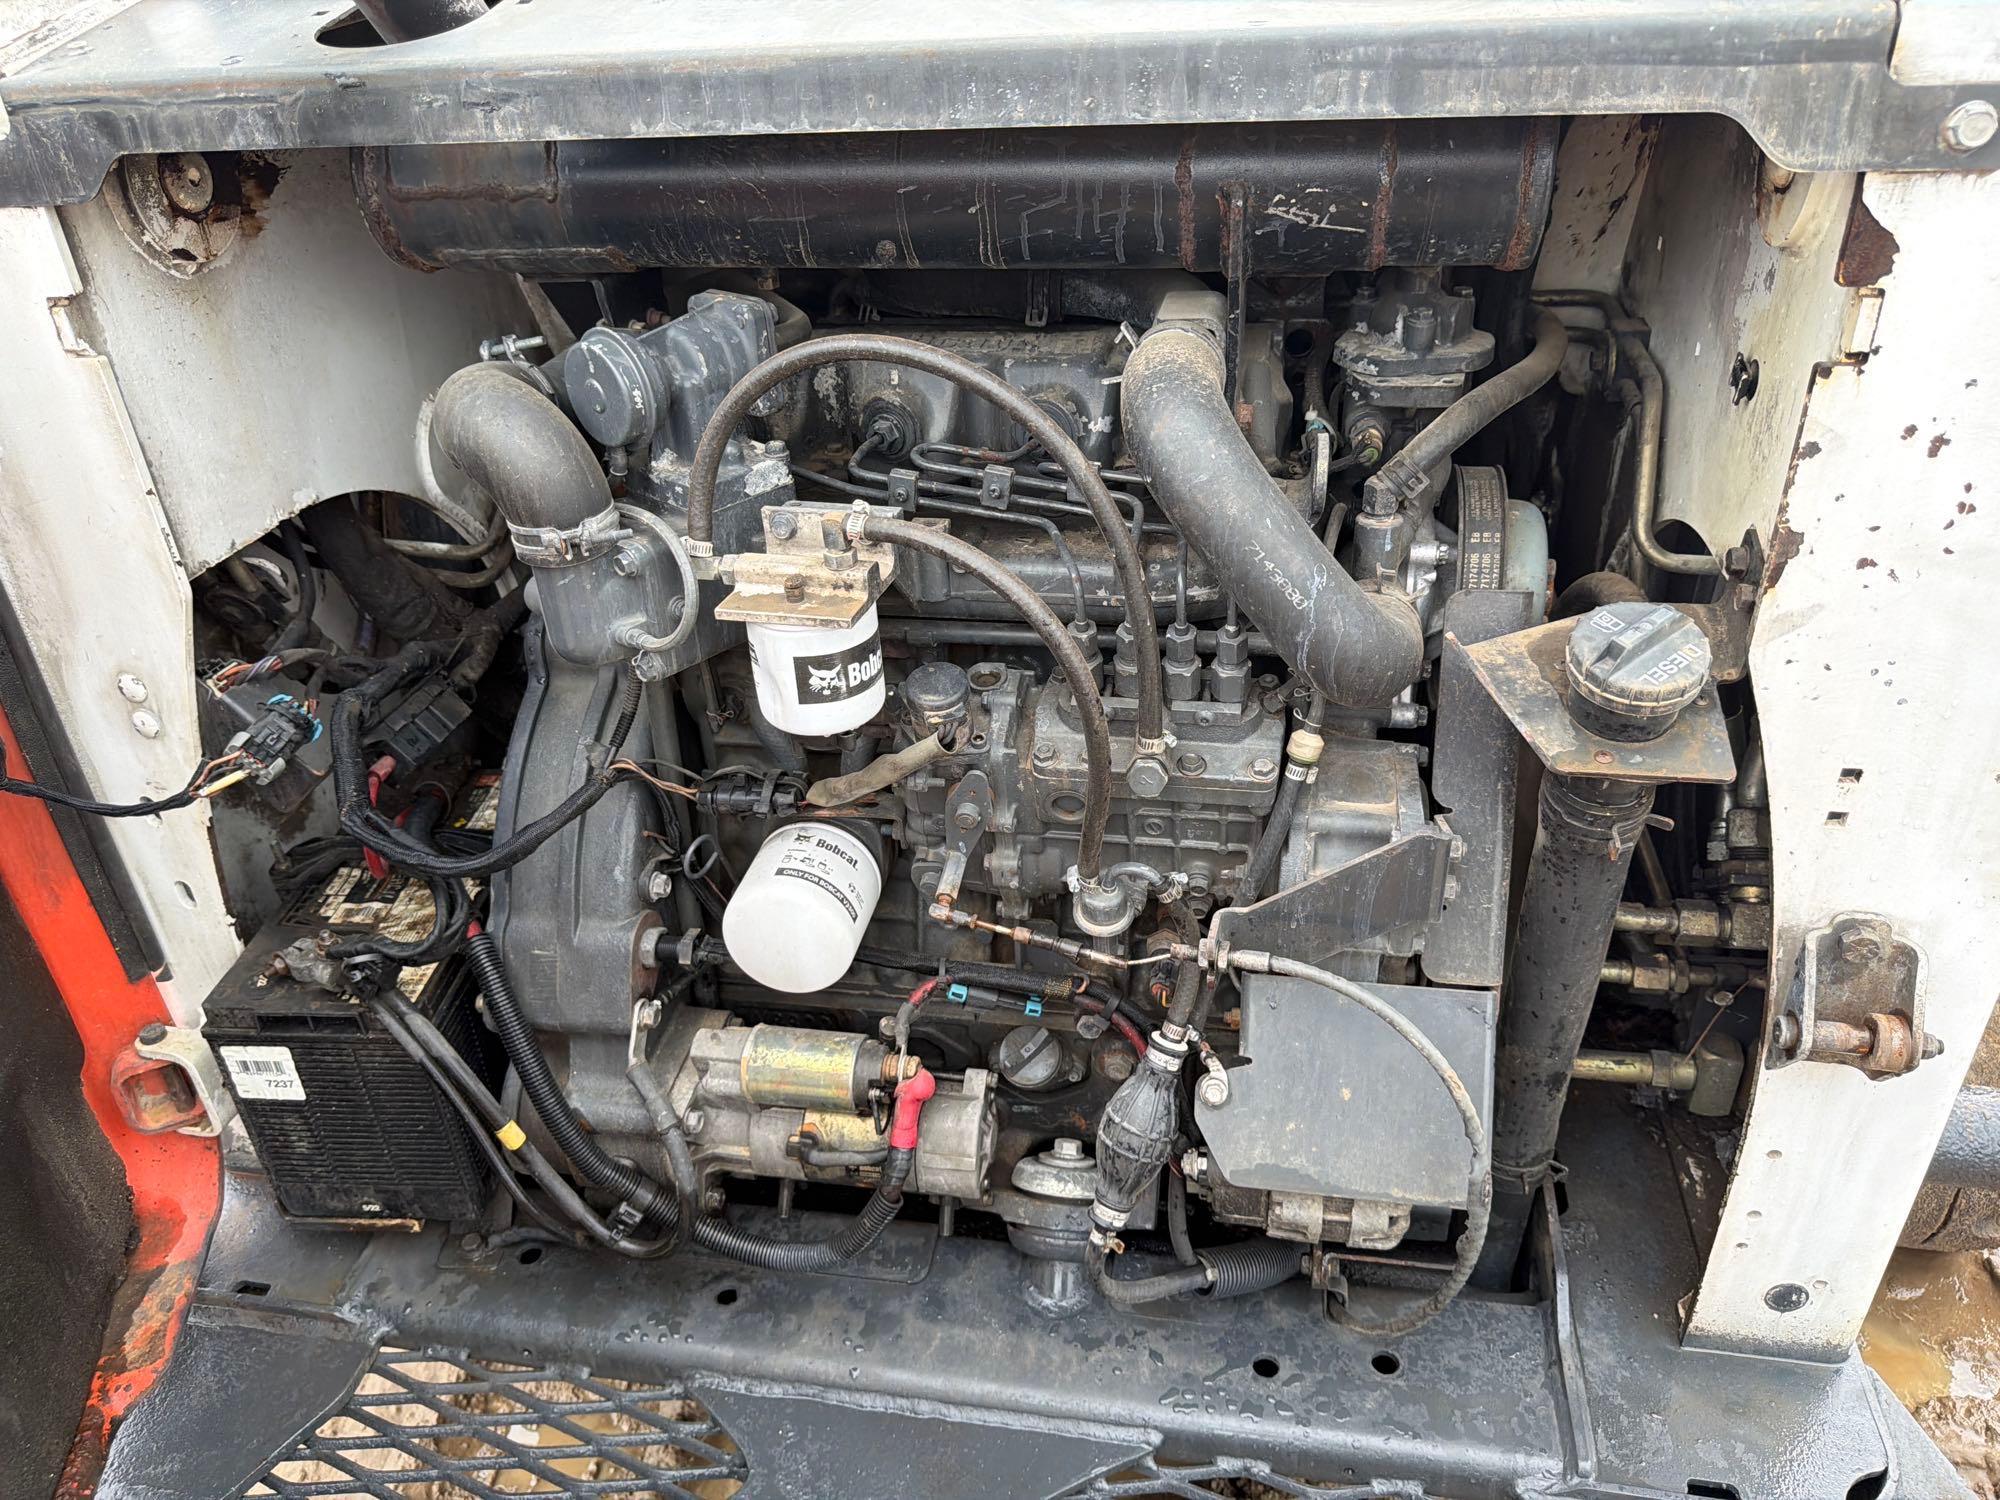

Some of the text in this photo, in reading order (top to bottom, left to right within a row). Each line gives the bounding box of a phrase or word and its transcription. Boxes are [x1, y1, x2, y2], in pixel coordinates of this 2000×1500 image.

[1468, 553, 1480, 589] 7174706
[1480, 553, 1491, 589] 7174706
[1639, 643, 1704, 686] DIESEL
[816, 838, 859, 870] Bobcat
[783, 869, 805, 880] ONLY
[804, 873, 820, 884] FOR
[819, 879, 844, 901] BOBCAT
[264, 1079, 294, 1089] 7237
